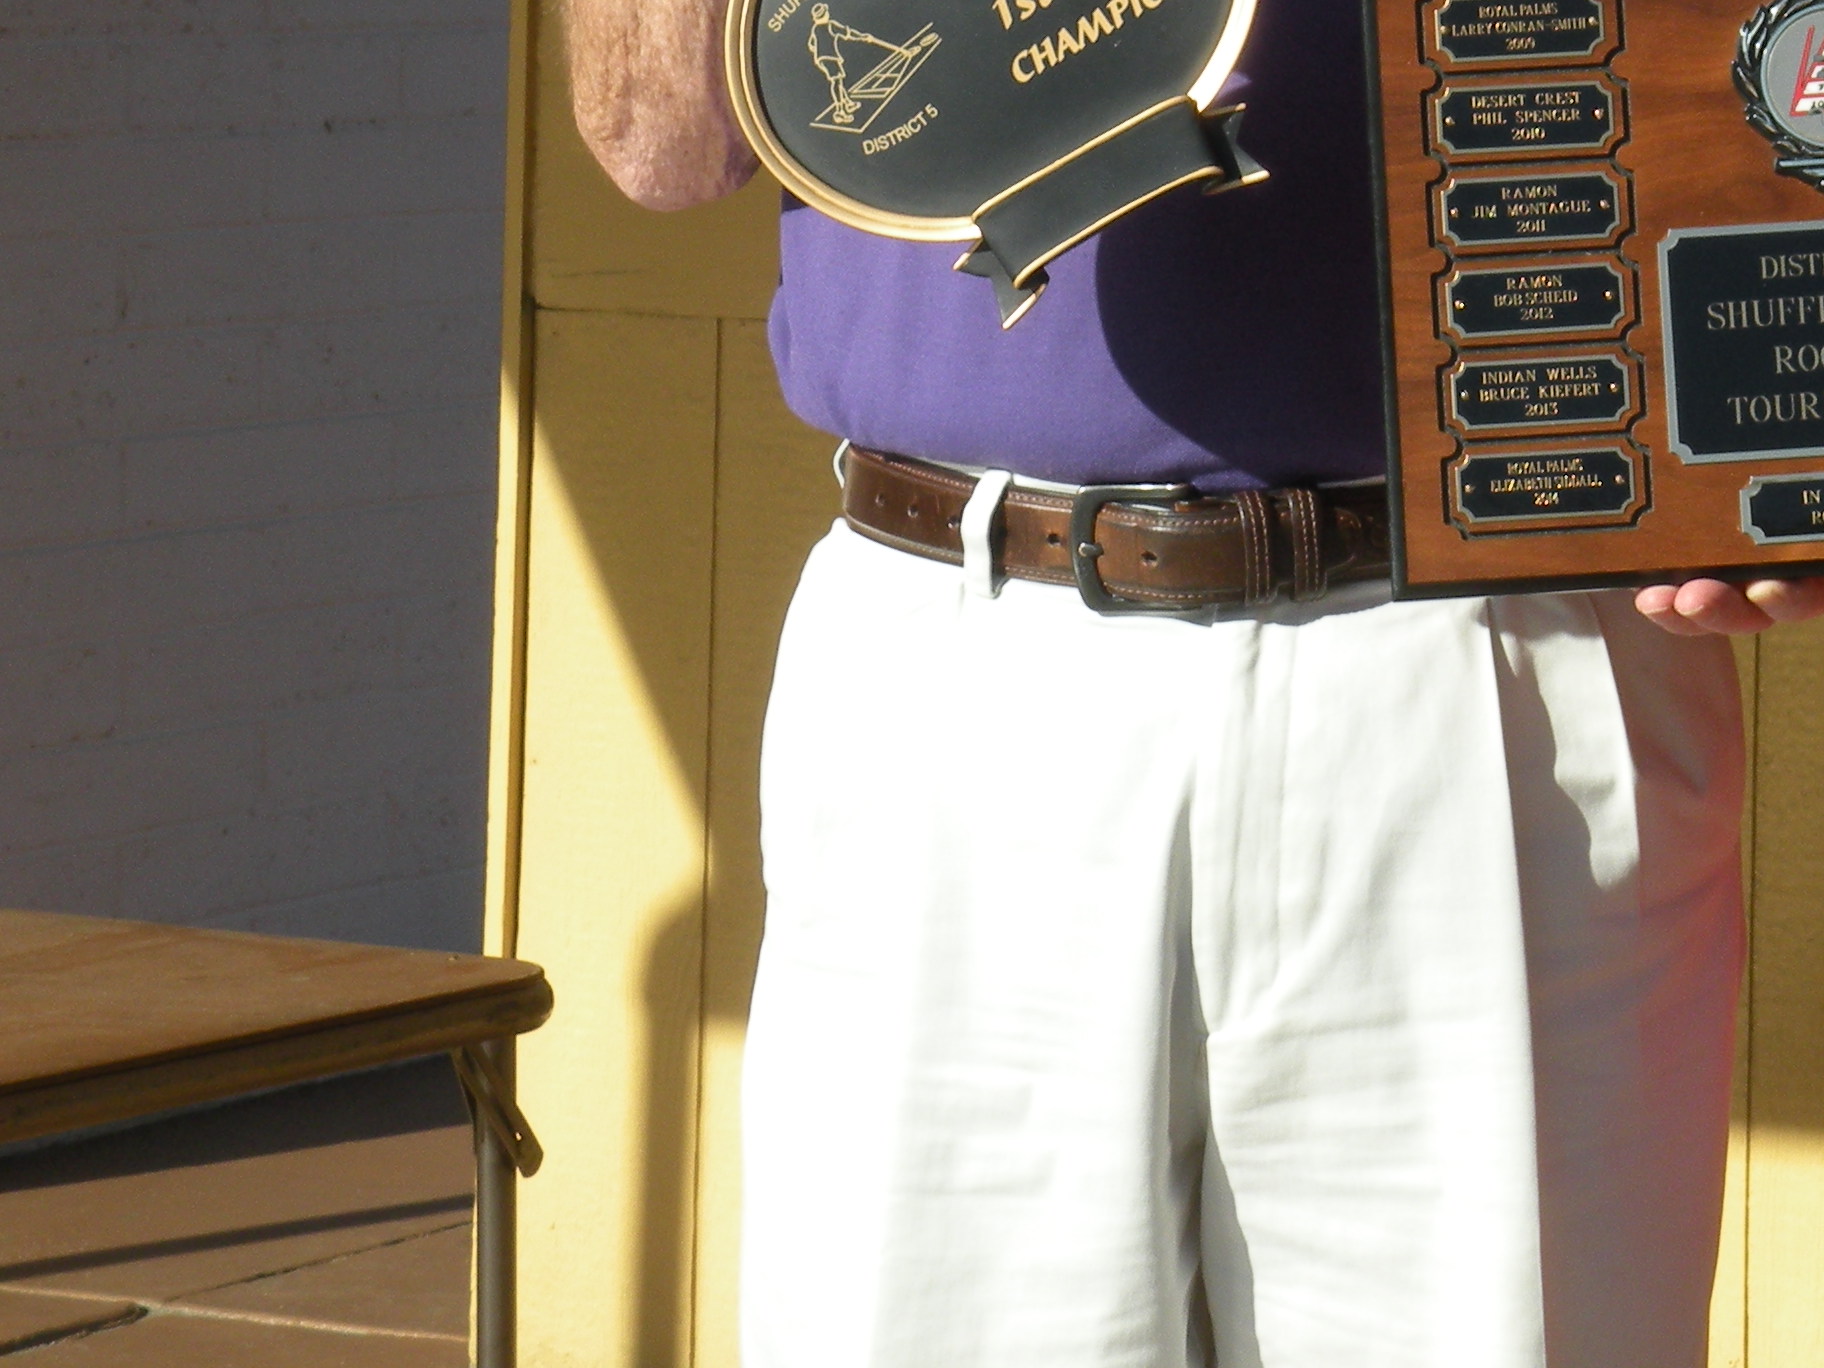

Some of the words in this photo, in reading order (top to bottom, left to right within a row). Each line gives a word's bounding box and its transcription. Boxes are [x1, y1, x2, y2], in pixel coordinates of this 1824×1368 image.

[1478, 4, 1519, 20] ROYAL
[1519, 2, 1559, 17] PALMS
[1452, 22, 1493, 37] LARRY
[1471, 93, 1526, 109] DESERT
[1534, 90, 1582, 106] CREST
[1471, 112, 1507, 126] PHIL
[1514, 108, 1582, 124] SPENCER
[862, 111, 926, 156] DISTRICT
[926, 103, 939, 119] 5
[1510, 126, 1546, 141] 2010
[1501, 184, 1559, 200] RAMON
[1471, 204, 1498, 220] JIM
[1506, 198, 1592, 219] MONTAGUE
[1515, 218, 1547, 234] 2011
[1505, 274, 1564, 292] RAMON
[1492, 293, 1524, 308] BOB
[1524, 288, 1579, 306] SCHEID
[1519, 306, 1555, 322] 2012
[1481, 368, 1537, 385] INDIAN
[1546, 365, 1598, 382] WELLS
[1478, 387, 1530, 403] BRUCE
[1537, 382, 1602, 400] KIEFERT
[1524, 401, 1559, 417] 2013
[1802, 488, 1822, 505] IN
